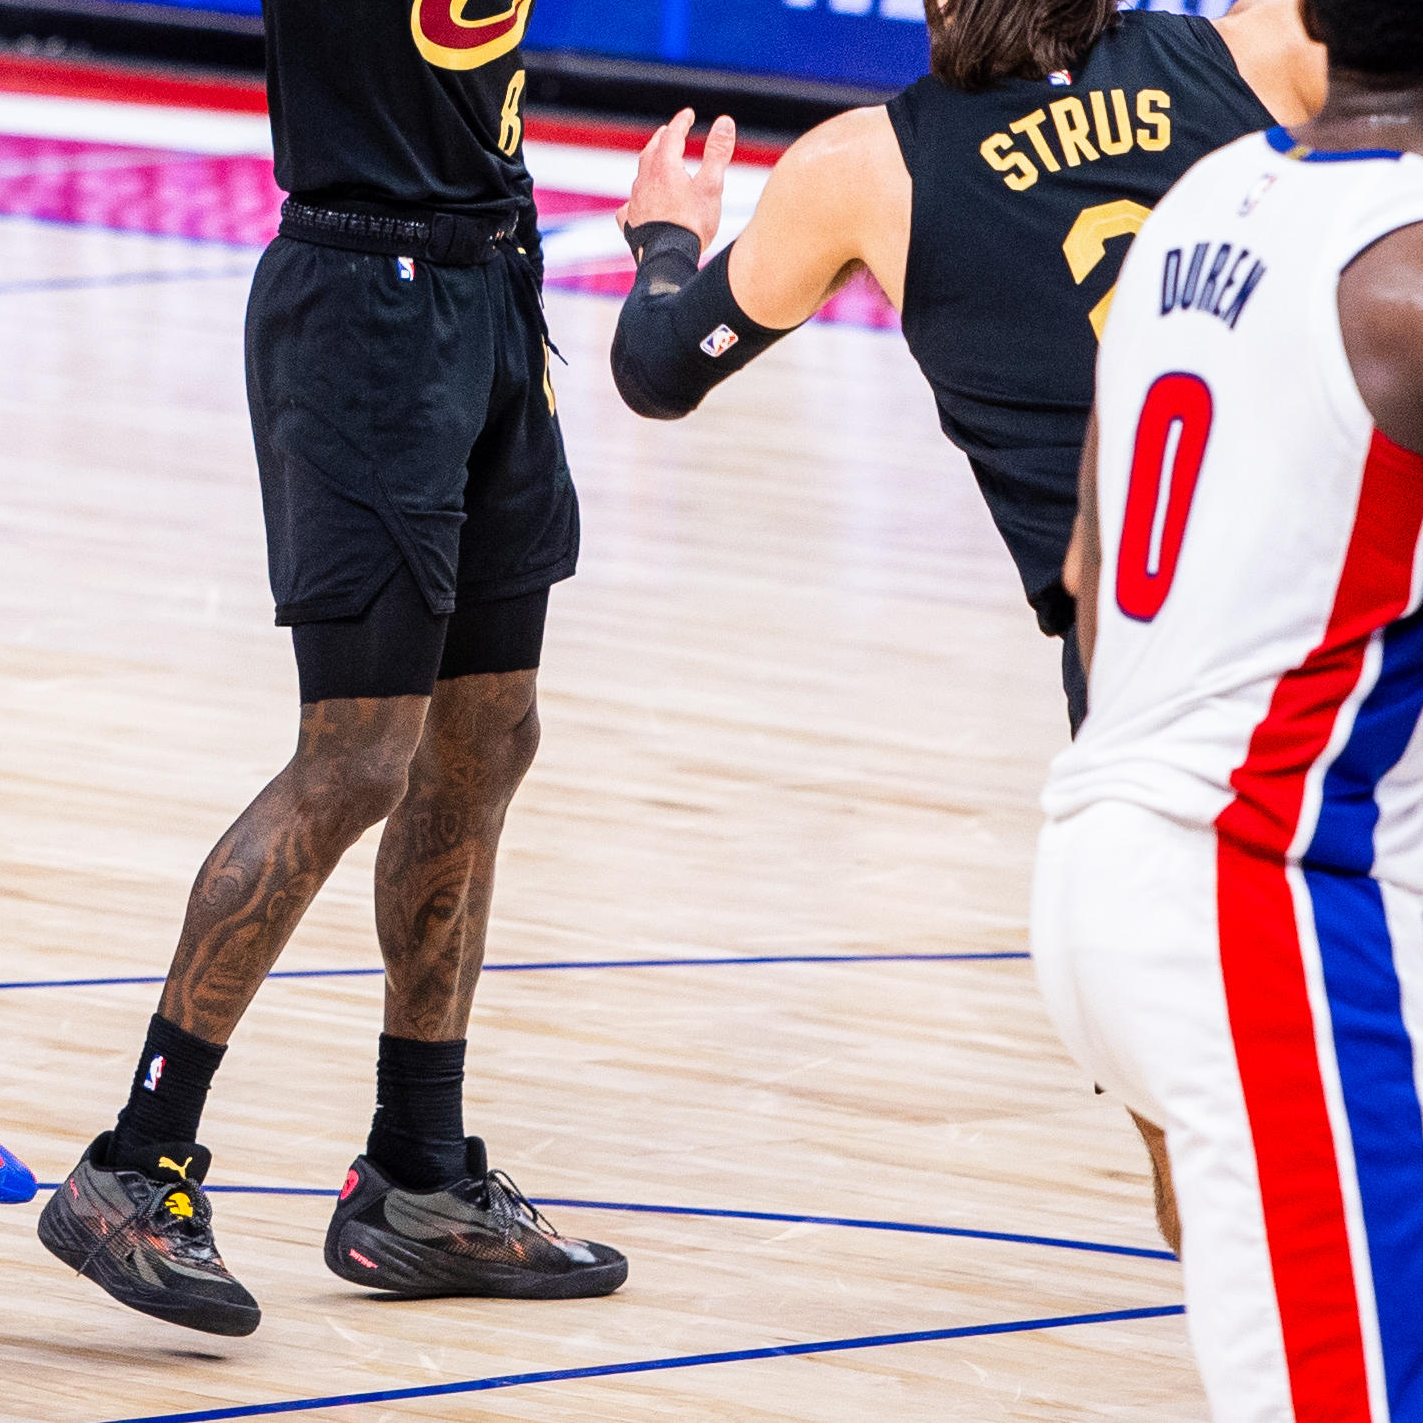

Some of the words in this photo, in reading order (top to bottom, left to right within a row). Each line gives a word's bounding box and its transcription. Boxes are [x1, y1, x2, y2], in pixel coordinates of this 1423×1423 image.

[978, 87, 1172, 192] STRUS
[1160, 241, 1267, 331] DUREN
[1115, 369, 1214, 625] 0
